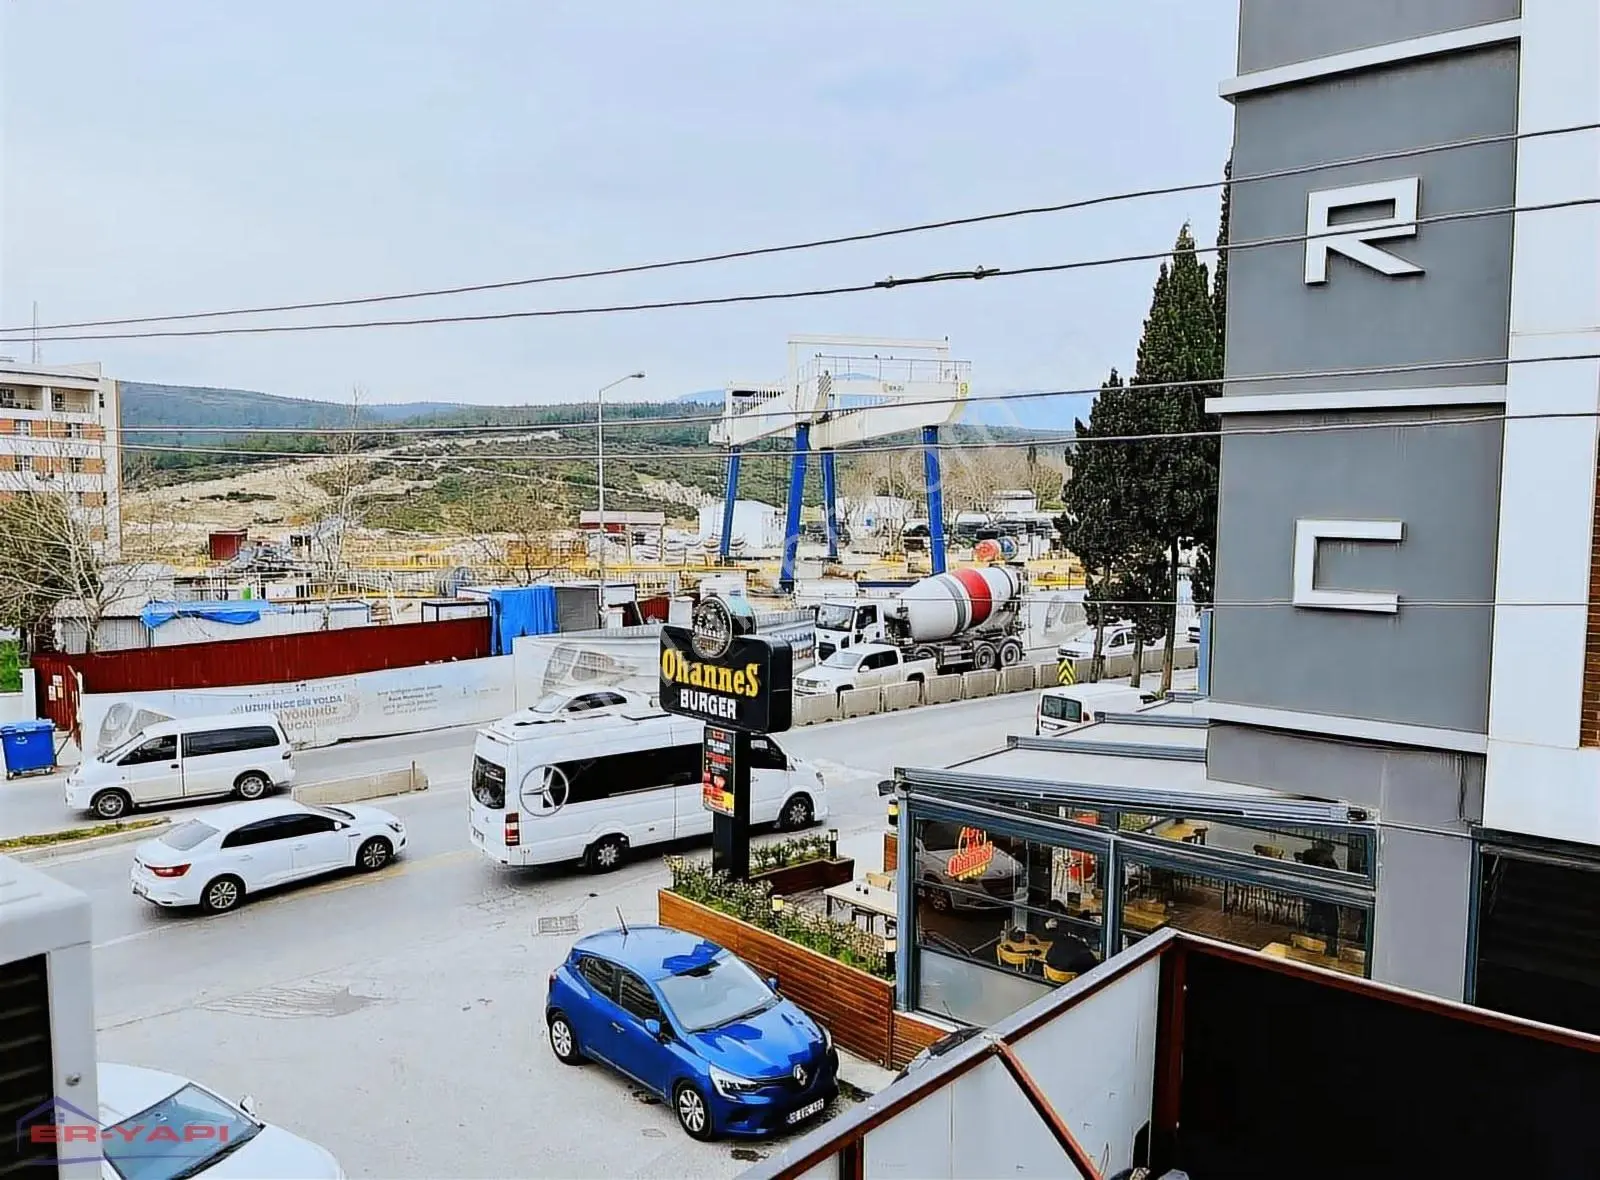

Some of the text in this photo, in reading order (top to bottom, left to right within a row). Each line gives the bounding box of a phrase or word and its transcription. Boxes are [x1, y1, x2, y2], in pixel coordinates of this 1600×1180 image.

[1303, 176, 1425, 285] R
[1292, 518, 1405, 614] C
[680, 688, 737, 720] BURGER
